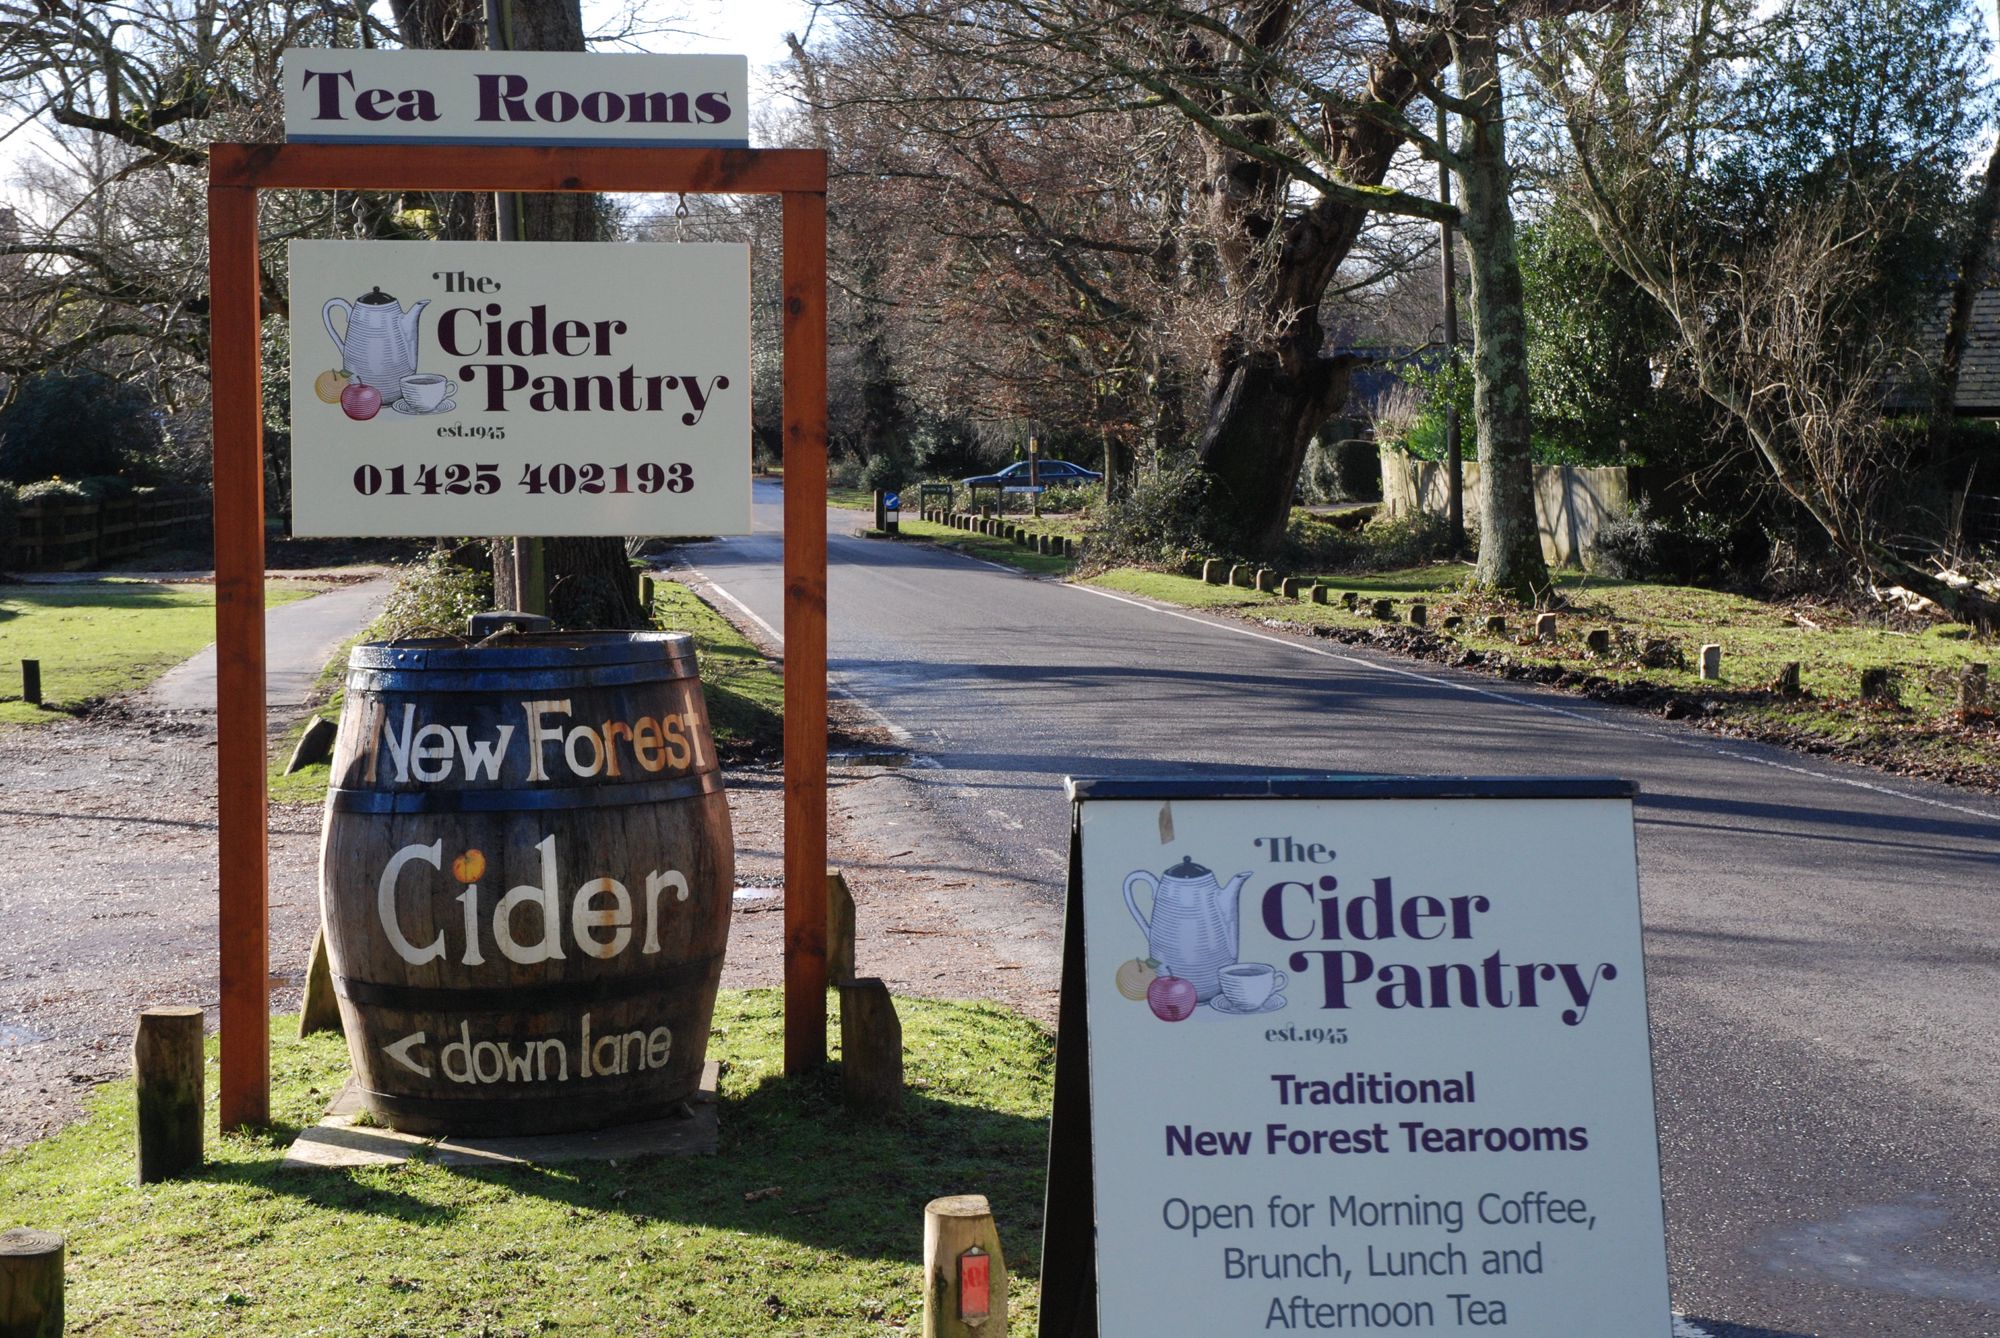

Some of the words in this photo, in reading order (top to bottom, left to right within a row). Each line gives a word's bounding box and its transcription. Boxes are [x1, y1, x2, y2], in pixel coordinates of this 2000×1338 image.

[302, 69, 442, 122] Tea
[474, 74, 732, 125] Rooms
[432, 270, 502, 295] The
[437, 303, 628, 358] Cider
[459, 363, 730, 427] Pantry
[436, 420, 506, 440] est.1945
[353, 463, 502, 496] 01425
[518, 462, 695, 495] 402193
[364, 702, 515, 783] New
[521, 689, 706, 782] Forest
[1254, 836, 1337, 865] The
[378, 834, 689, 966] Cider
[1261, 875, 1491, 942] Cider
[1289, 949, 1618, 1027] Pantry
[440, 1019, 569, 1085] down
[581, 1012, 673, 1079] lane
[1265, 1021, 1349, 1045] est.1945
[1271, 1071, 1476, 1106] Traditional
[1165, 1124, 1252, 1157] New
[1266, 1123, 1389, 1155] Forest
[1399, 1121, 1589, 1153] Tearooms
[1162, 1197, 1254, 1238] Open
[1267, 1194, 1315, 1228] for
[1330, 1193, 1464, 1234] Morning
[1477, 1190, 1597, 1231] Coffee,
[1224, 1244, 1352, 1285] Brunch,
[1367, 1242, 1468, 1277] Lunch
[1481, 1240, 1543, 1276] and
[1265, 1296, 1434, 1330] Afternoon
[1447, 1293, 1508, 1326] Tea
